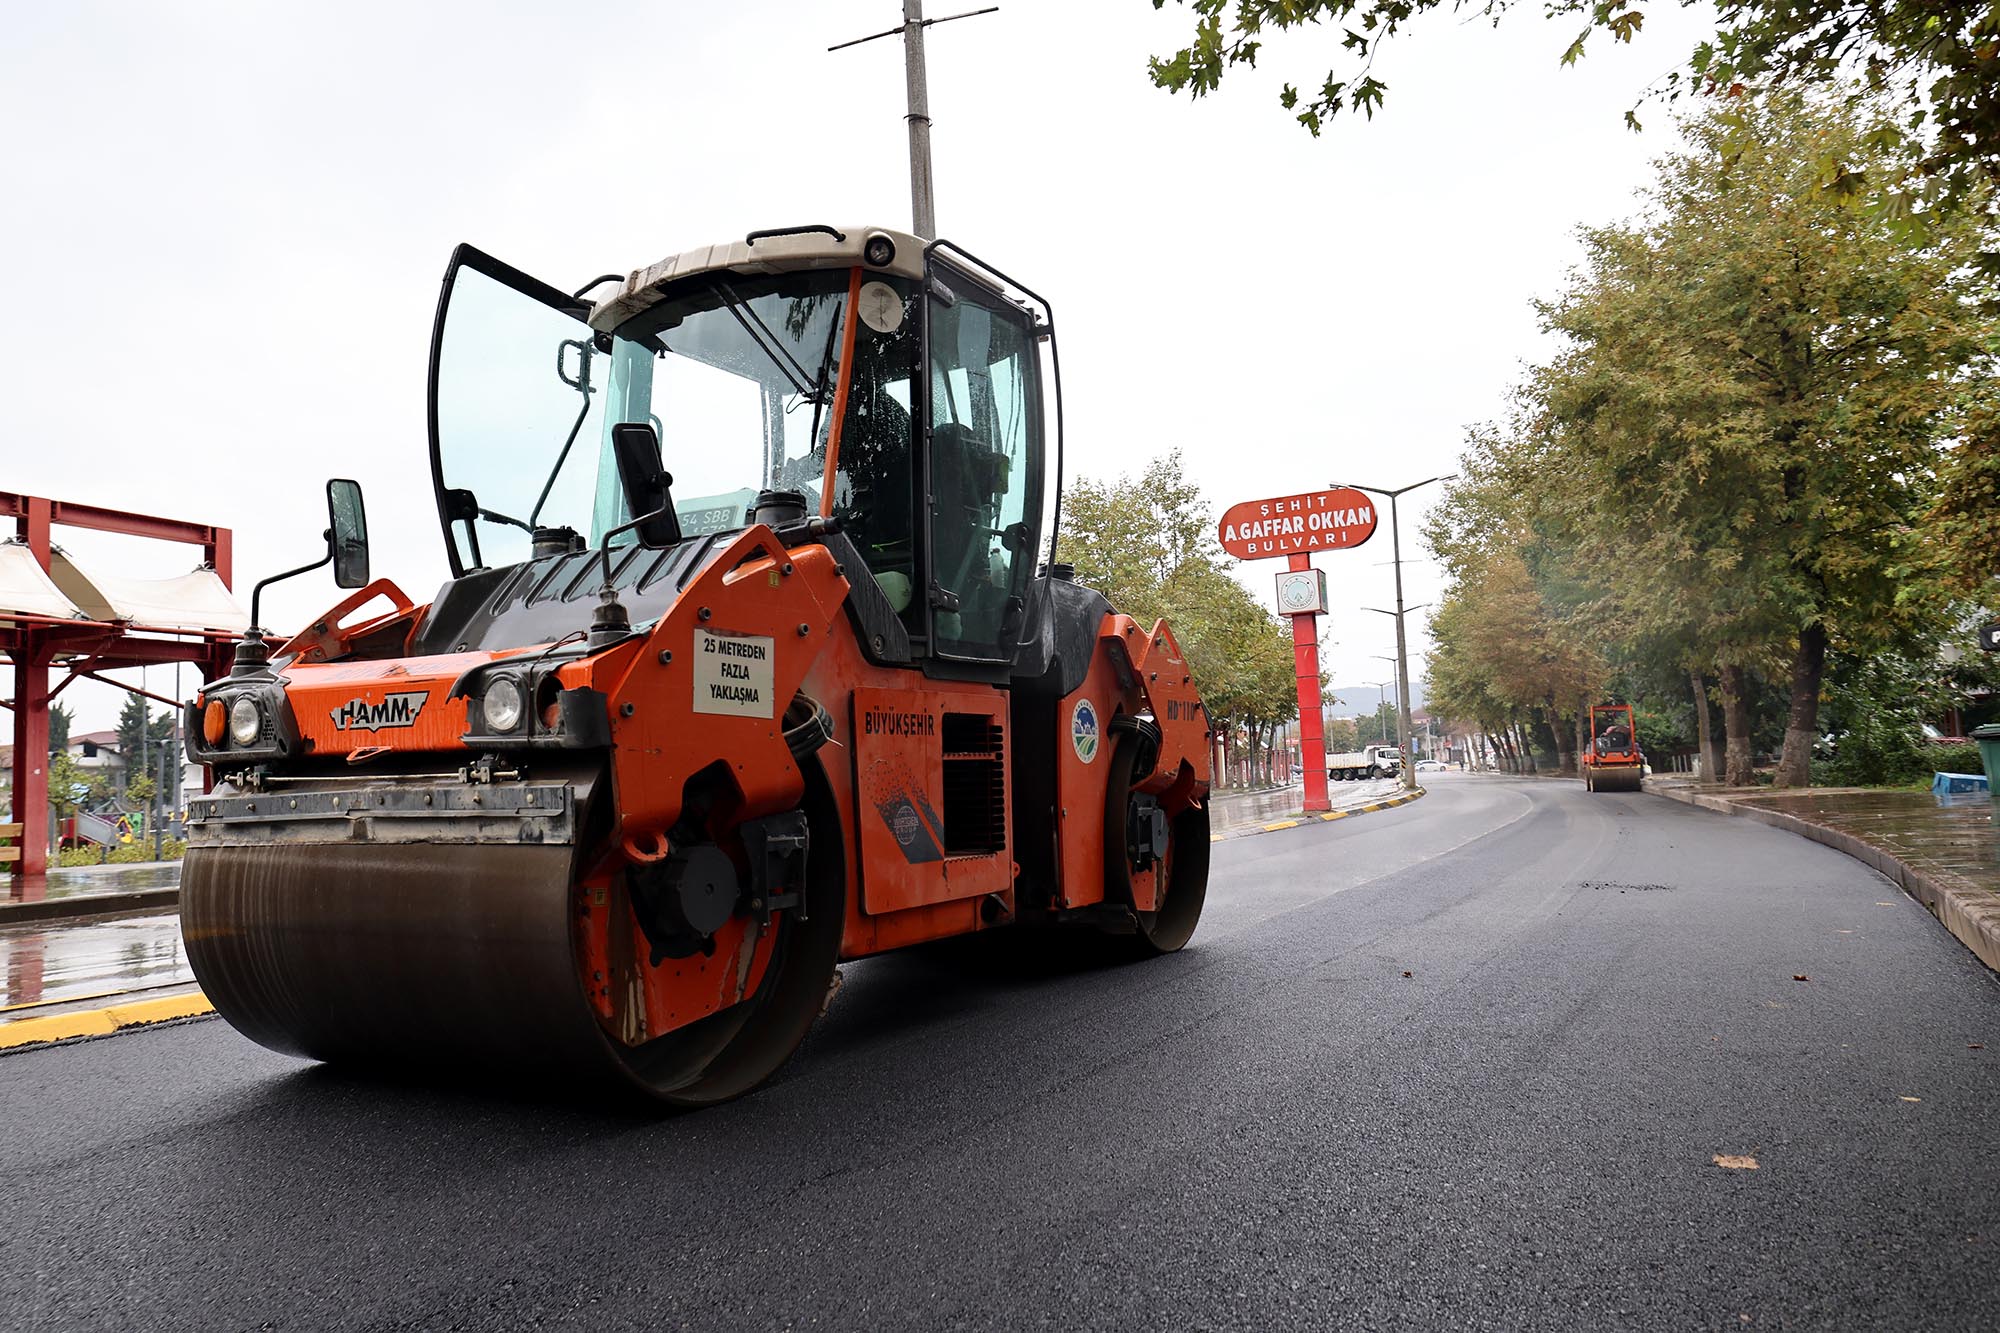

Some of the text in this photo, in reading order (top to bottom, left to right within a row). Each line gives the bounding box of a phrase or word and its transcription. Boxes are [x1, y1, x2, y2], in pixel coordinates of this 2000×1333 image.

[1261, 496, 1327, 517] ŞEHİT
[682, 509, 730, 527] 54 SBB
[1224, 506, 1372, 542] A.GAFFAR OKKAN
[1247, 531, 1347, 553] BULVARI
[704, 638, 766, 660] 25 METREDEN
[721, 662, 750, 680] FAZLA
[710, 683, 760, 705] YAKLAŞMA
[340, 698, 410, 725] HAMM
[865, 705, 935, 738] BÜYÜKŞEHİR
